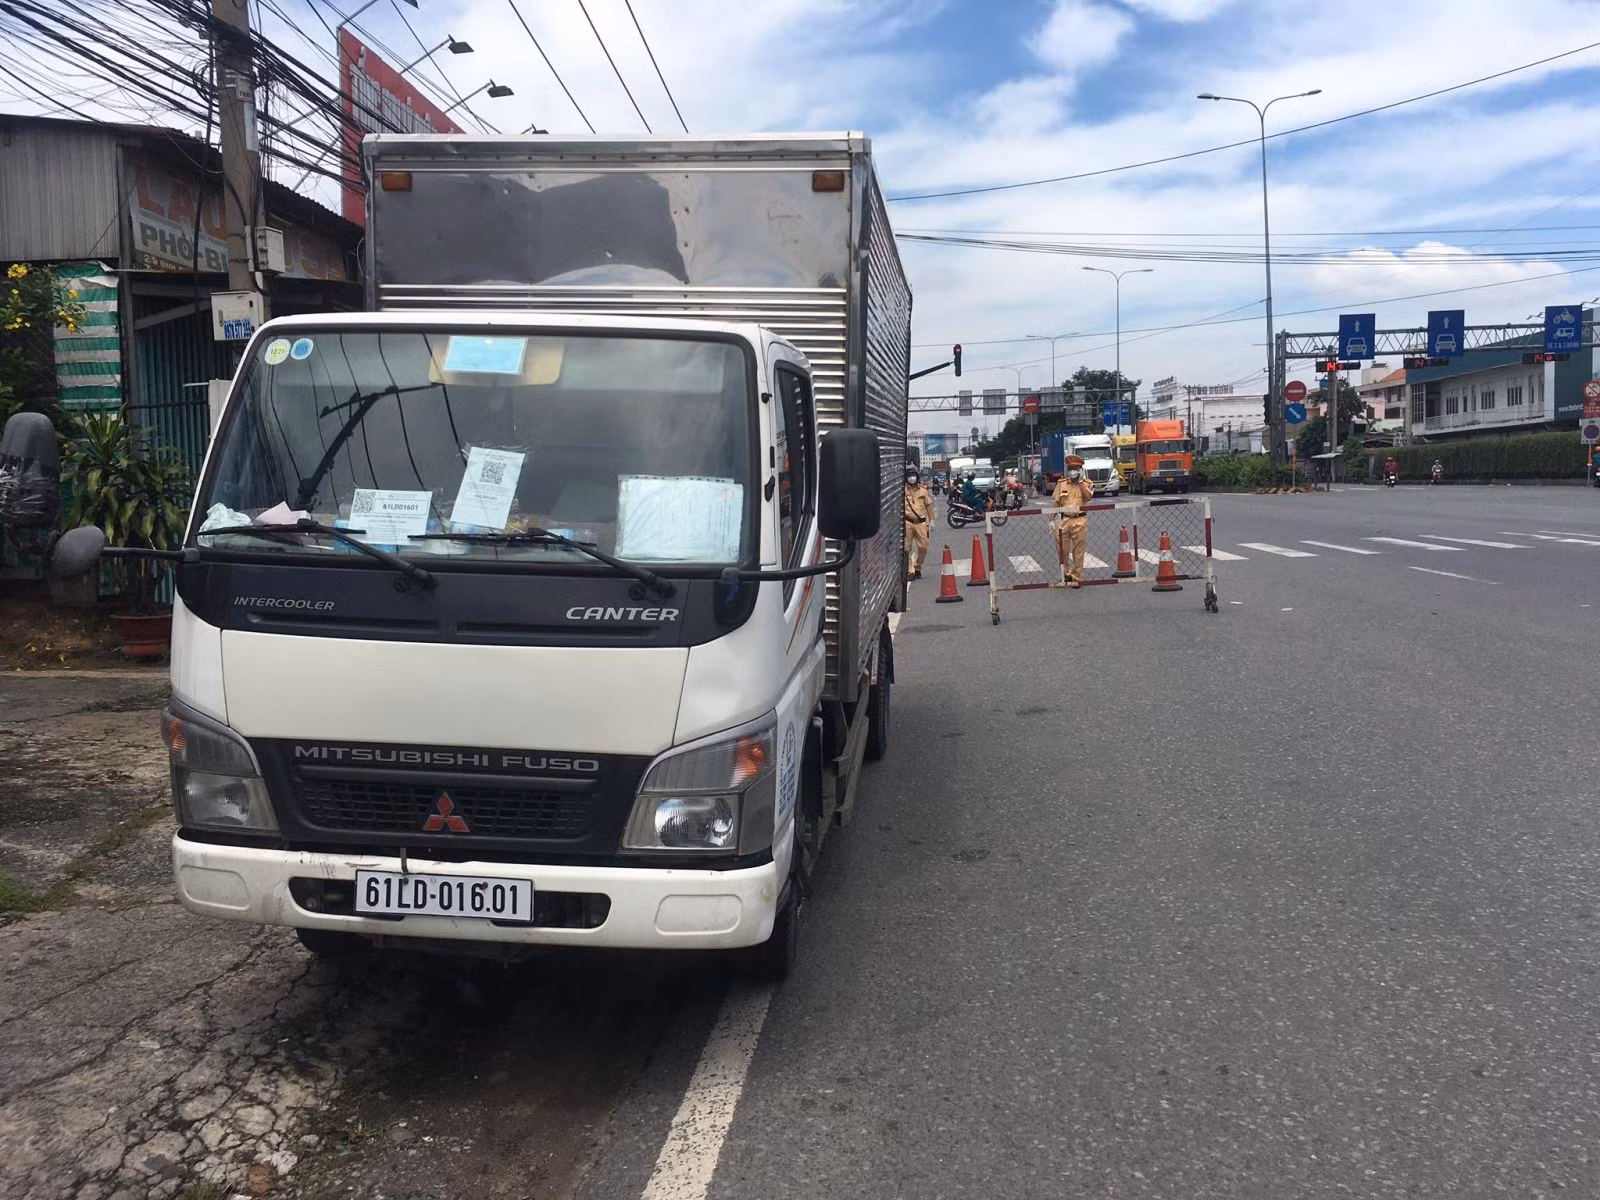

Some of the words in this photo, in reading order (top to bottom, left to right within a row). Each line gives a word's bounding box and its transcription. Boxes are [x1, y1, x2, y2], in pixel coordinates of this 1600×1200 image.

[1326, 361, 1337, 371] 14
[234, 596, 335, 610] INTERCOOLER
[566, 606, 680, 621] CANTER
[295, 745, 489, 766] MITSUBISHI
[502, 755, 600, 772] FUSO
[366, 876, 518, 915] 61LD-016.01
